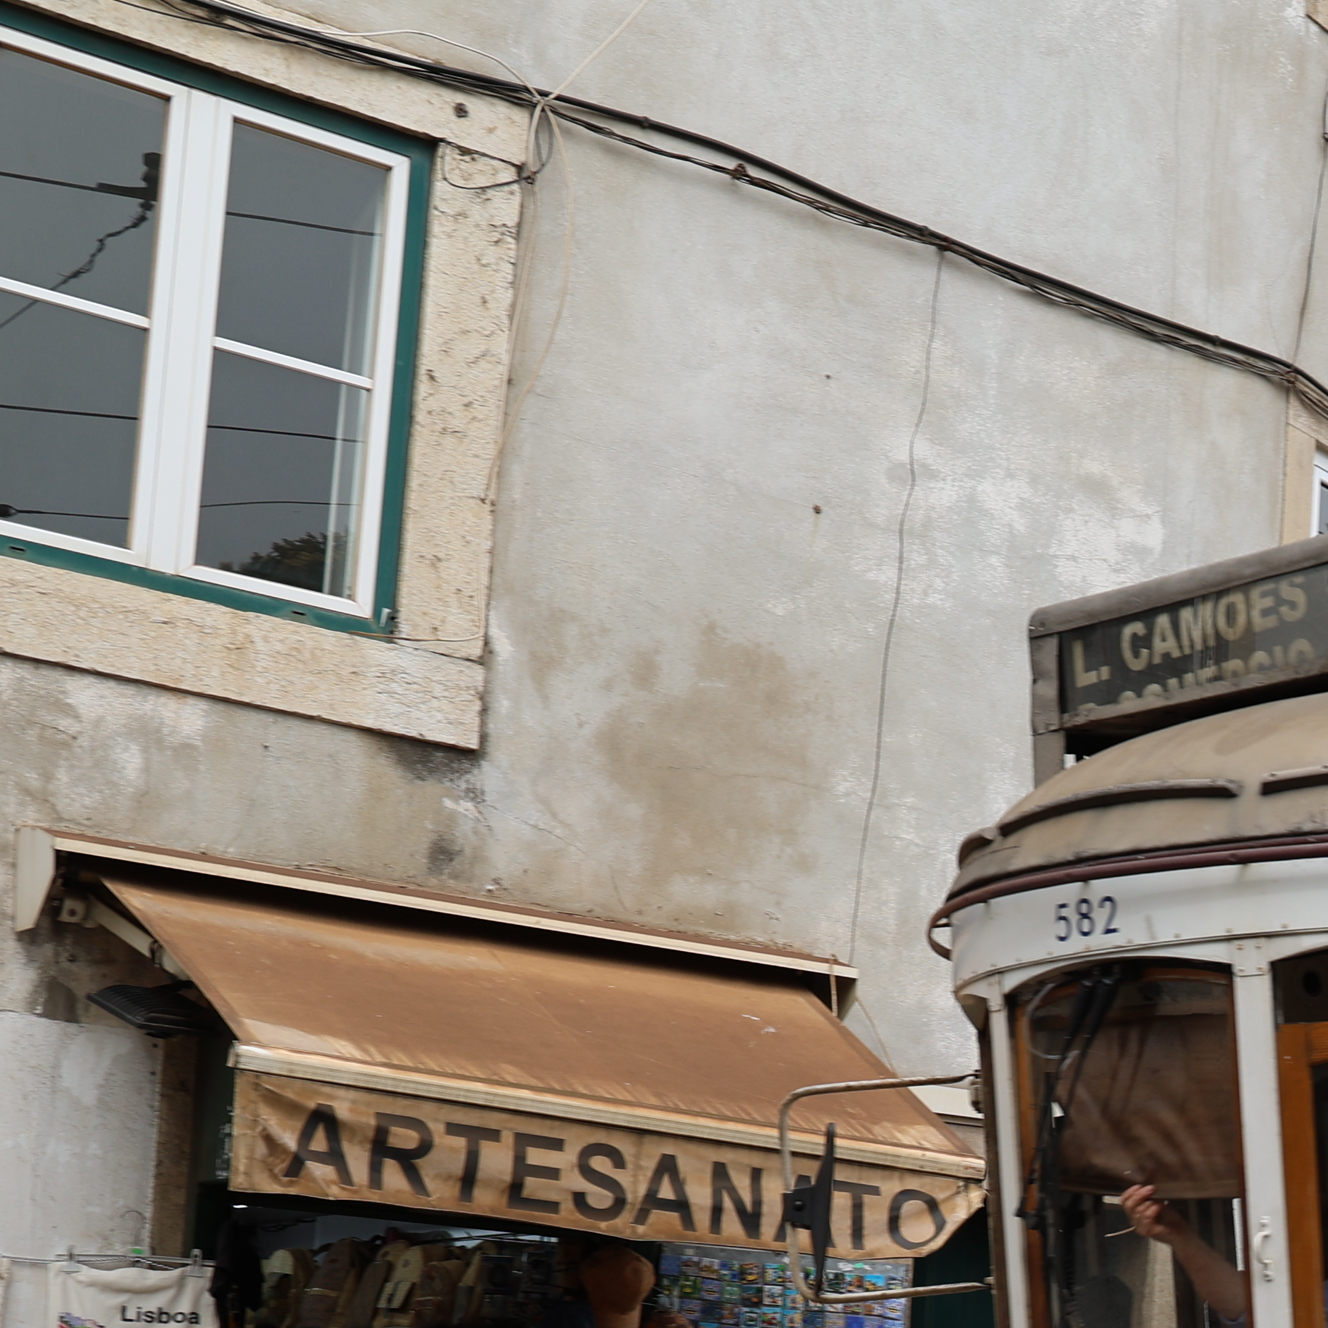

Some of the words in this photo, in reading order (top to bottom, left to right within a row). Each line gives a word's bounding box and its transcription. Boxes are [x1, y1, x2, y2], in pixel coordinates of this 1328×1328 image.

[1071, 639, 1112, 688] L.
[1120, 576, 1308, 672] CAMOES
[1055, 896, 1120, 942] 582
[121, 1304, 201, 1325] Lisboa
